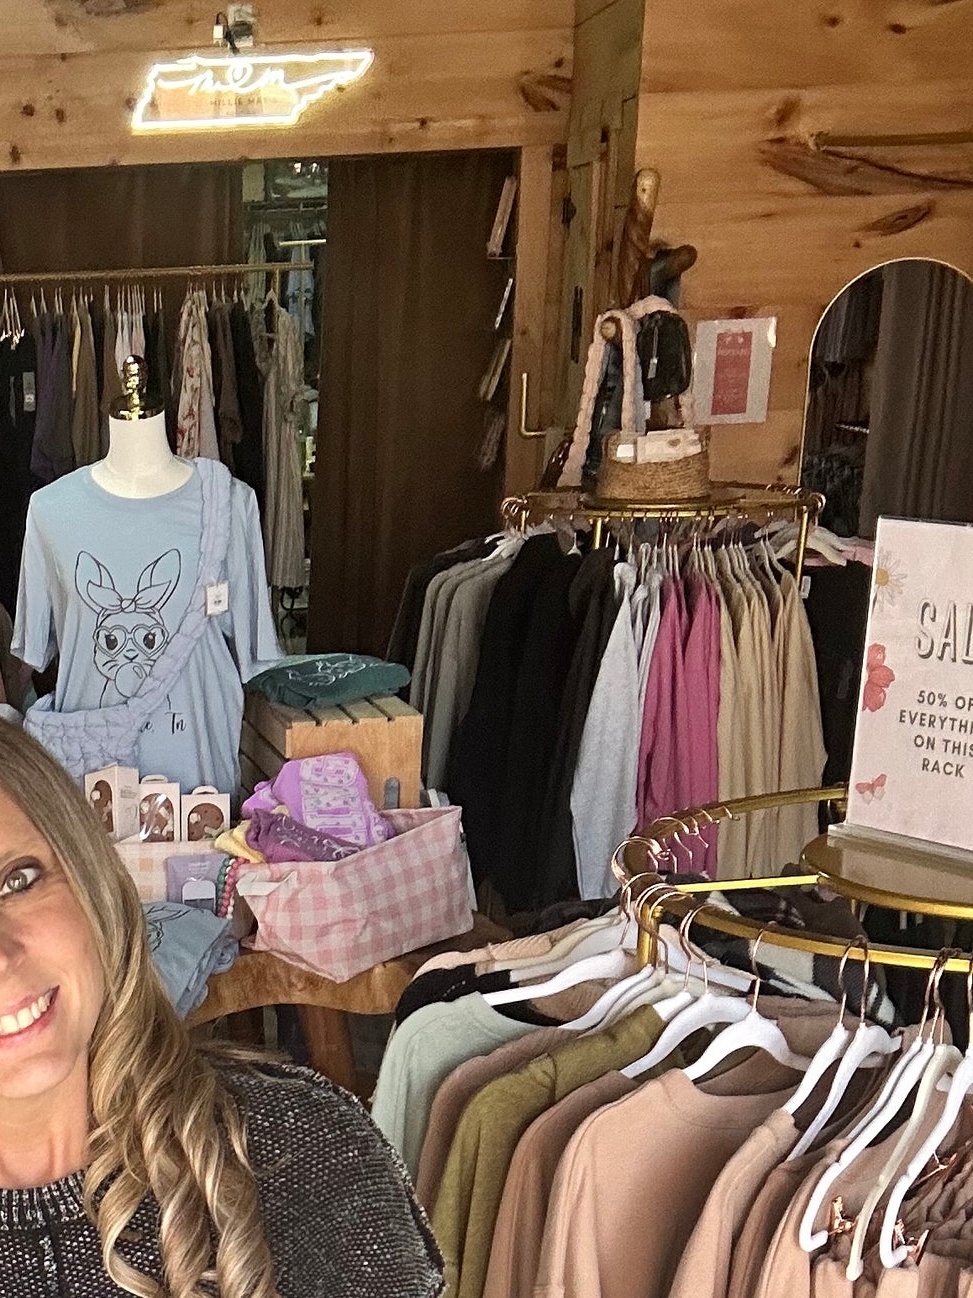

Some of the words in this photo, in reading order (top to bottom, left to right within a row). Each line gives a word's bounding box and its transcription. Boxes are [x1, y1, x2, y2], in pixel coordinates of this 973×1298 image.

[917, 690, 948, 708] 50%
[164, 711, 187, 735] Tn
[914, 735, 935, 751] ON
[922, 757, 965, 779] RACK
